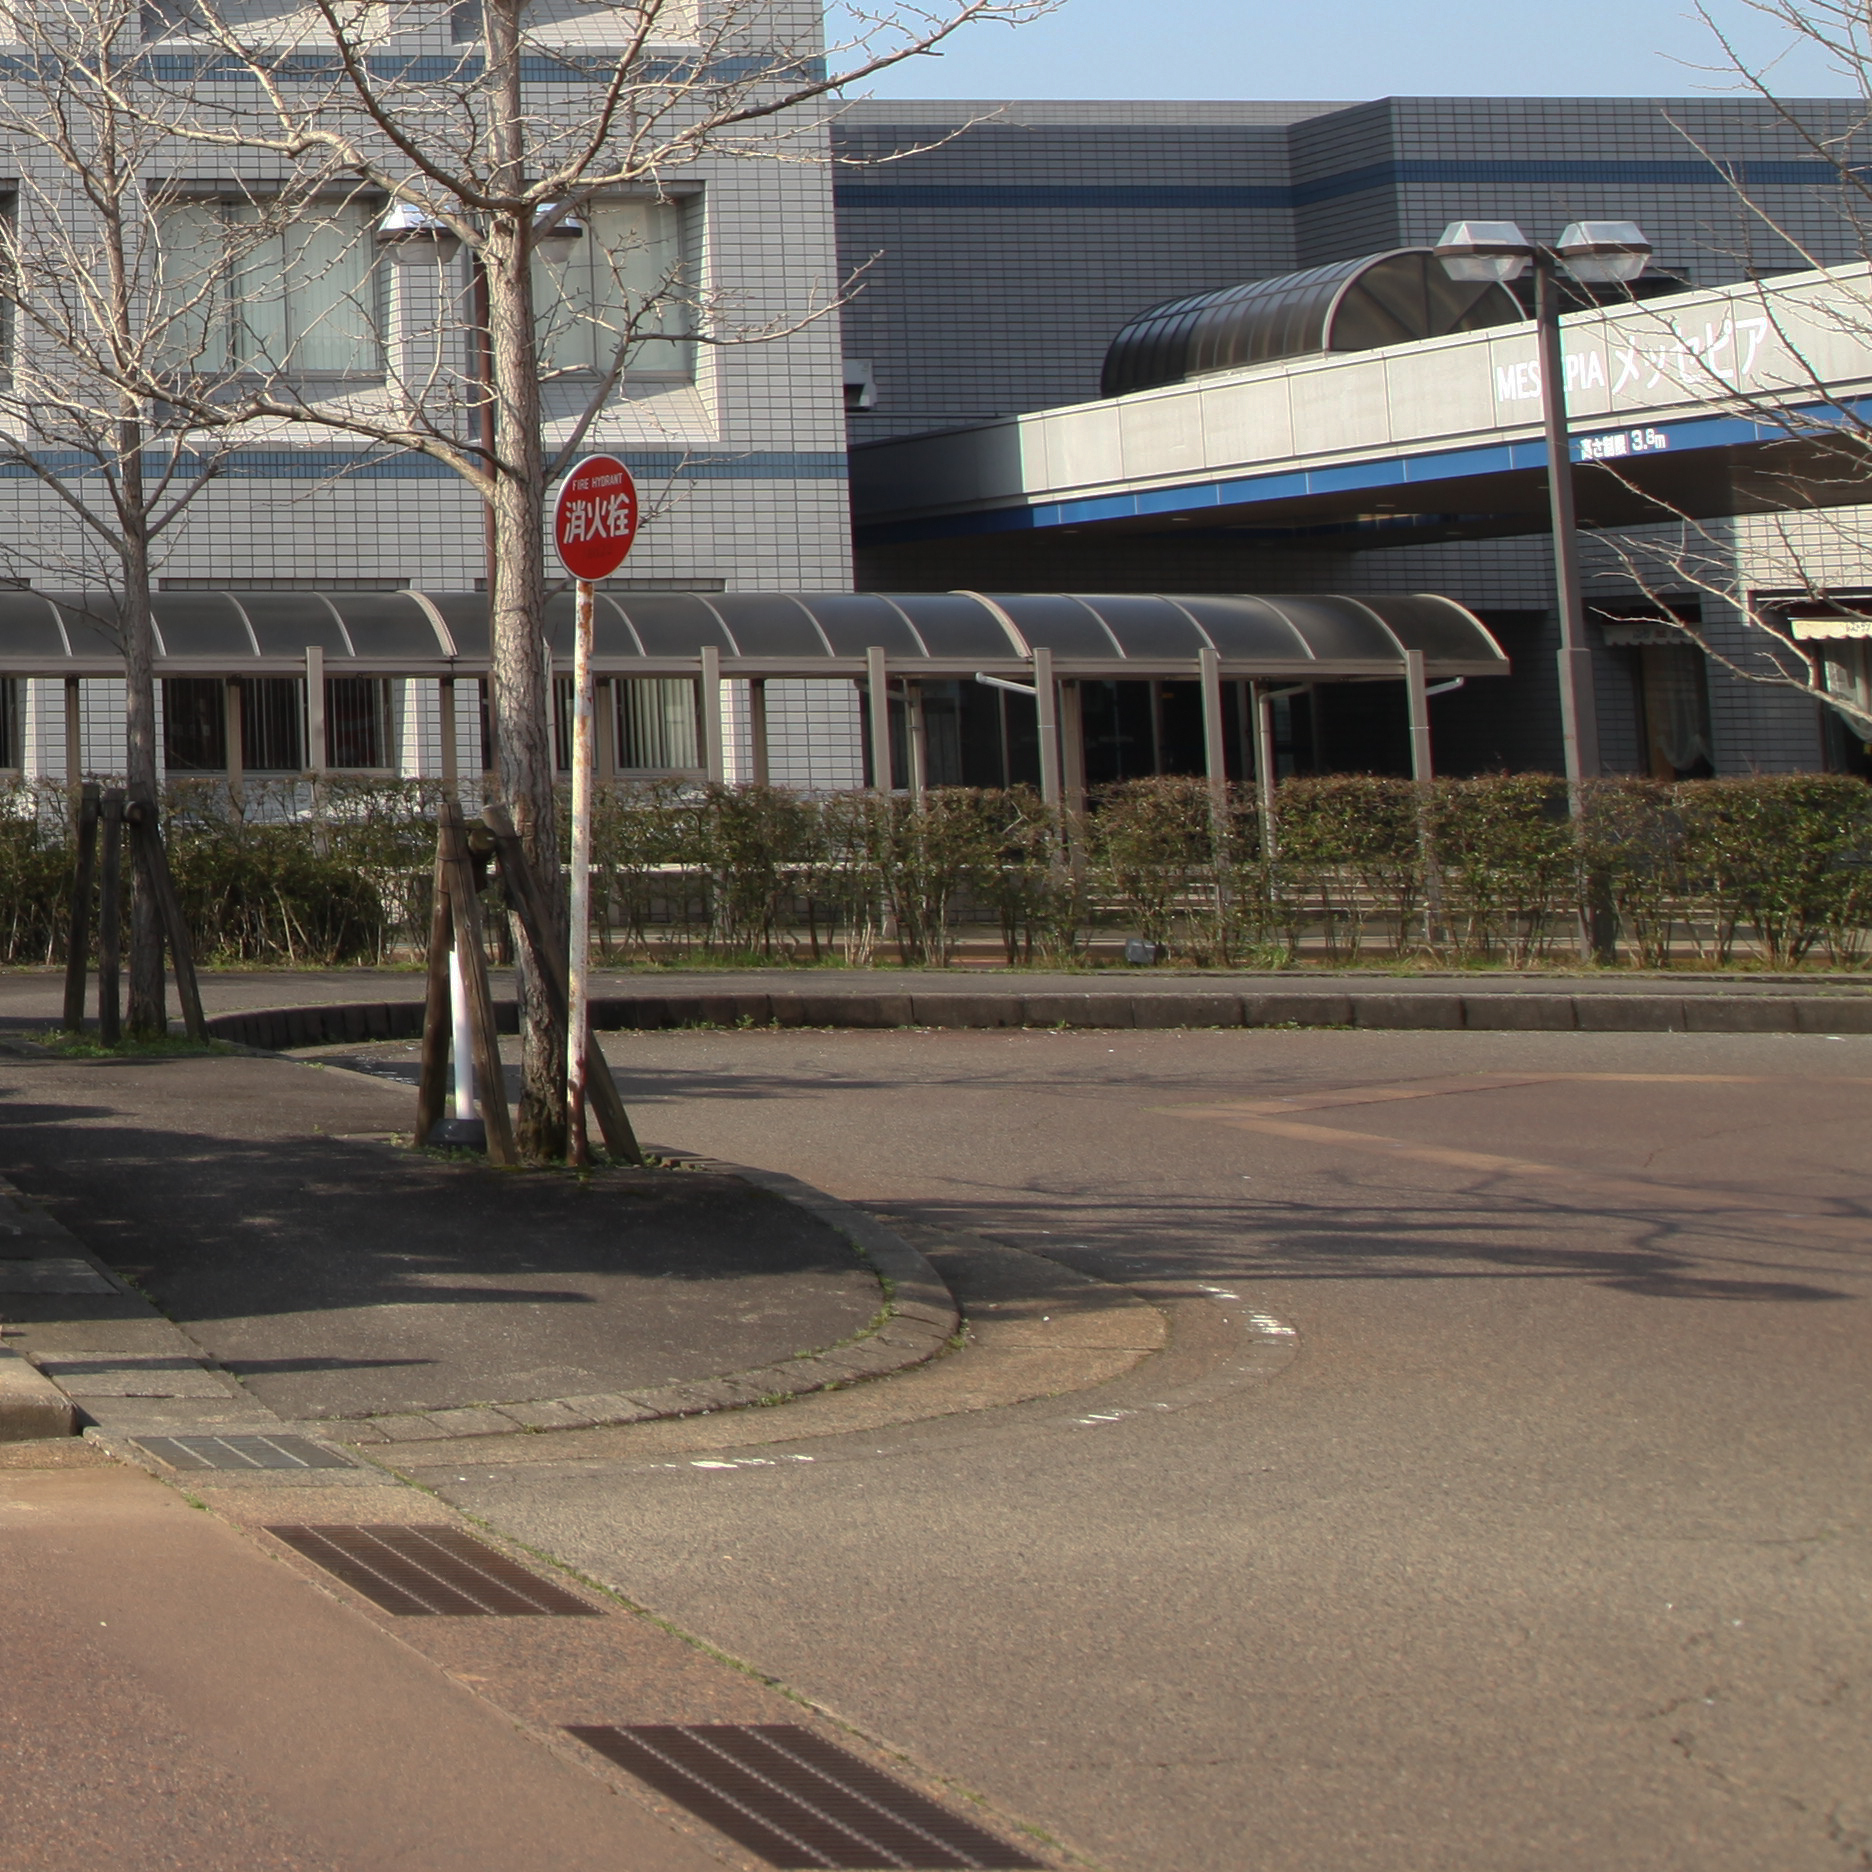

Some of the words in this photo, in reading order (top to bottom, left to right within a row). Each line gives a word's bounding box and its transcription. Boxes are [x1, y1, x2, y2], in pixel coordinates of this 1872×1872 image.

[1496, 350, 1606, 402] MESPIA
[1631, 428, 1666, 451] 3.8m
[572, 478, 589, 491] FIRE
[592, 472, 624, 489] HYDRANT
[562, 492, 631, 545] 消火栓
